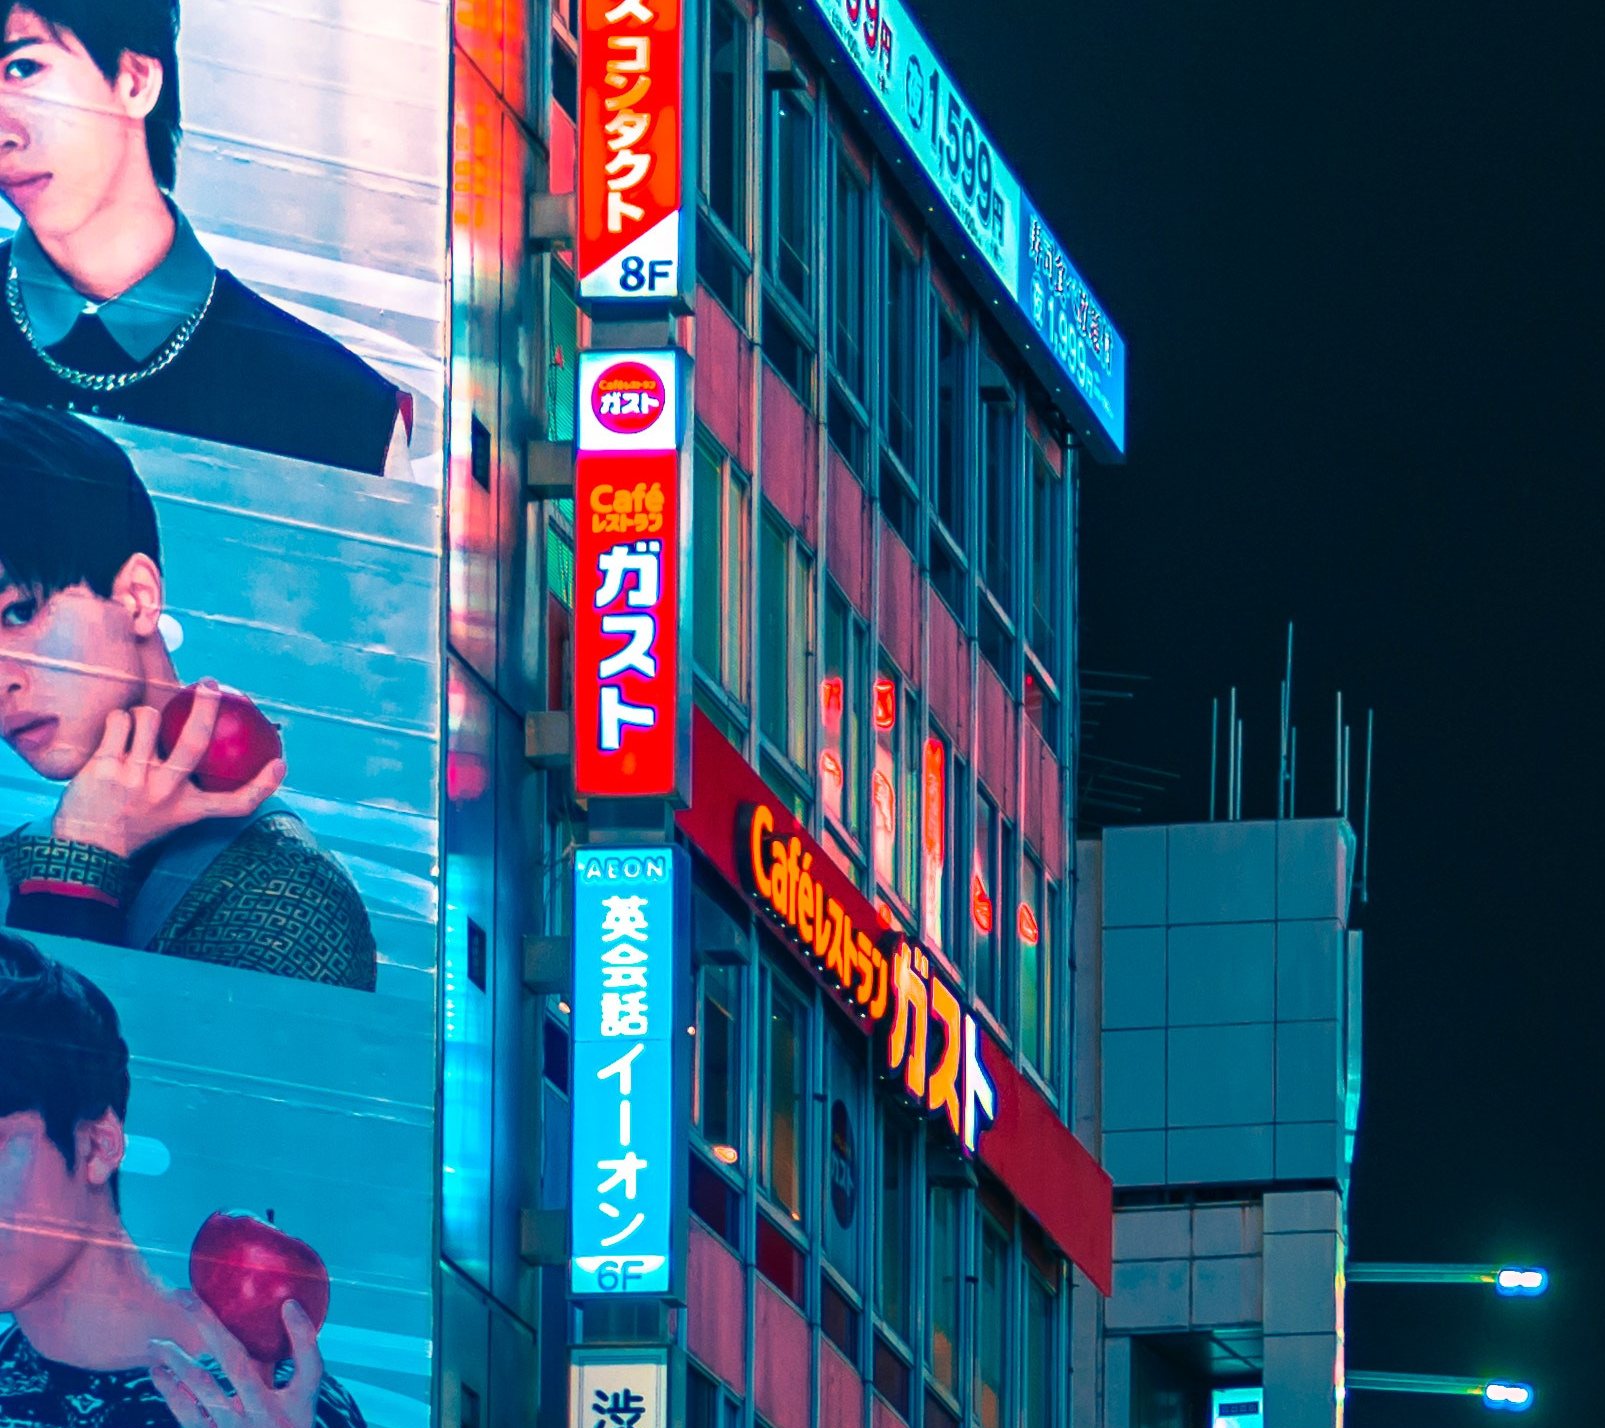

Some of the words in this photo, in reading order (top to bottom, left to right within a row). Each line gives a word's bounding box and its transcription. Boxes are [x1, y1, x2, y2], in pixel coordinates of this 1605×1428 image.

[618, 256, 674, 292] 8F
[599, 393, 660, 417] ガスト
[590, 481, 665, 514] Café
[591, 512, 664, 533] レストラン
[595, 540, 662, 752] ガスト
[584, 857, 666, 879] AEON
[889, 941, 996, 1154] ガスト
[596, 896, 648, 1247] 英会話イーオン
[597, 1259, 645, 1291] 6F
